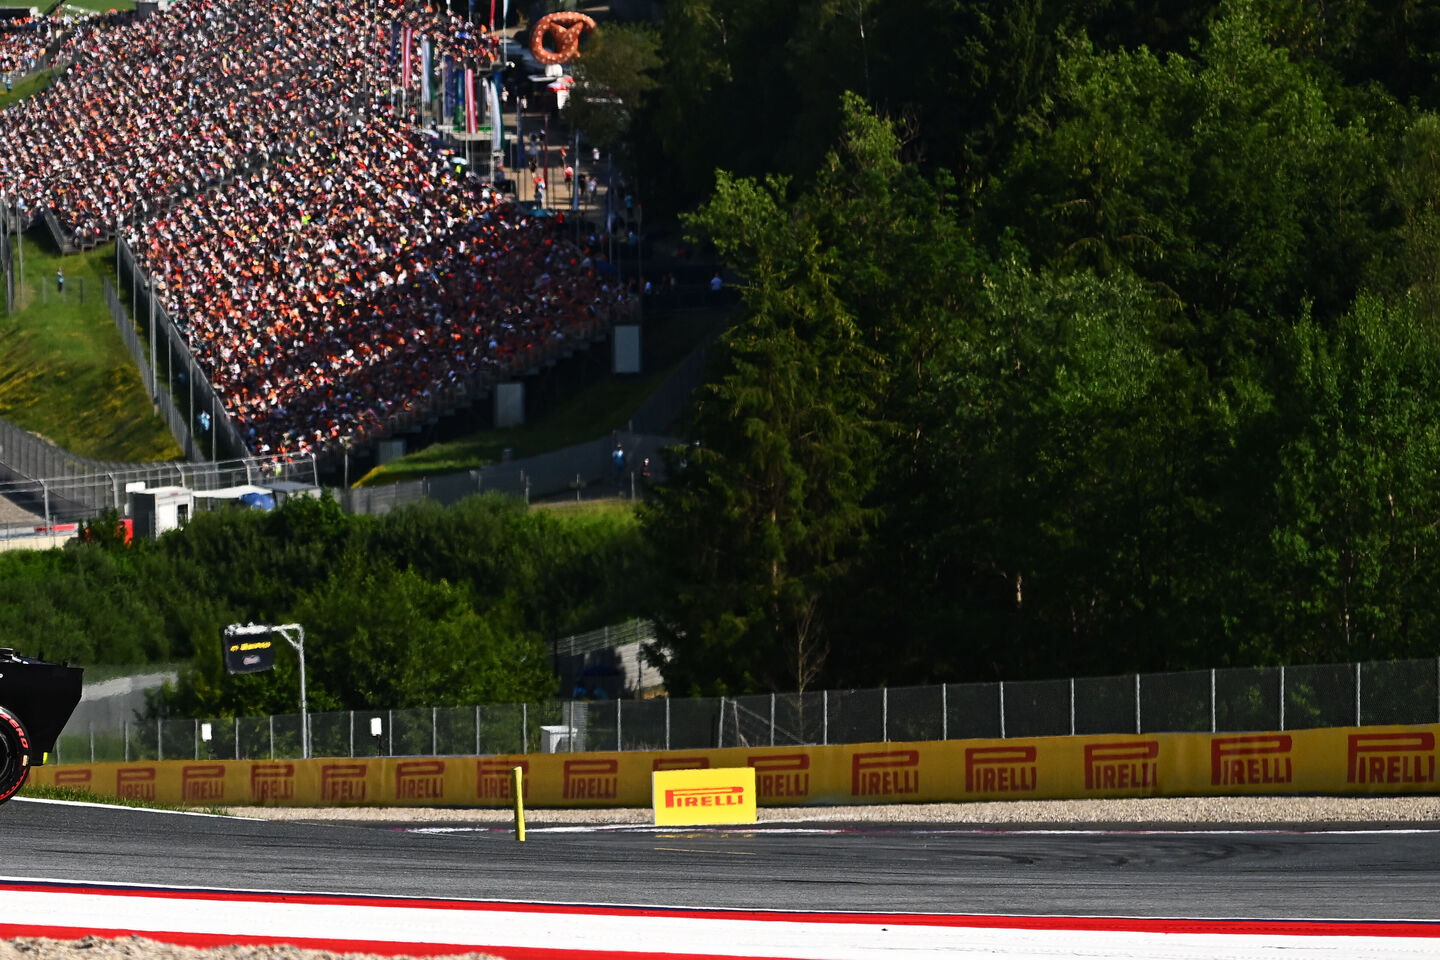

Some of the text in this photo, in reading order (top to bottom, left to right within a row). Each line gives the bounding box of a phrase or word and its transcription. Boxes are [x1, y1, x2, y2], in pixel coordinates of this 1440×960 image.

[851, 750, 919, 795] PIRELLI
[965, 746, 1037, 792] PIRELLI
[1084, 741, 1159, 790] PIRELLI
[1211, 734, 1293, 786] PIRELLI
[1347, 732, 1435, 784] PIRELLI
[117, 767, 156, 801] PIRELLI
[182, 765, 225, 800] PIRELLI
[251, 764, 294, 800] PIRELLI
[321, 764, 366, 800] PIRELLI
[396, 761, 445, 799] PIRELLI
[563, 759, 617, 799] PIRELLI
[665, 786, 744, 808] PIRELLI
